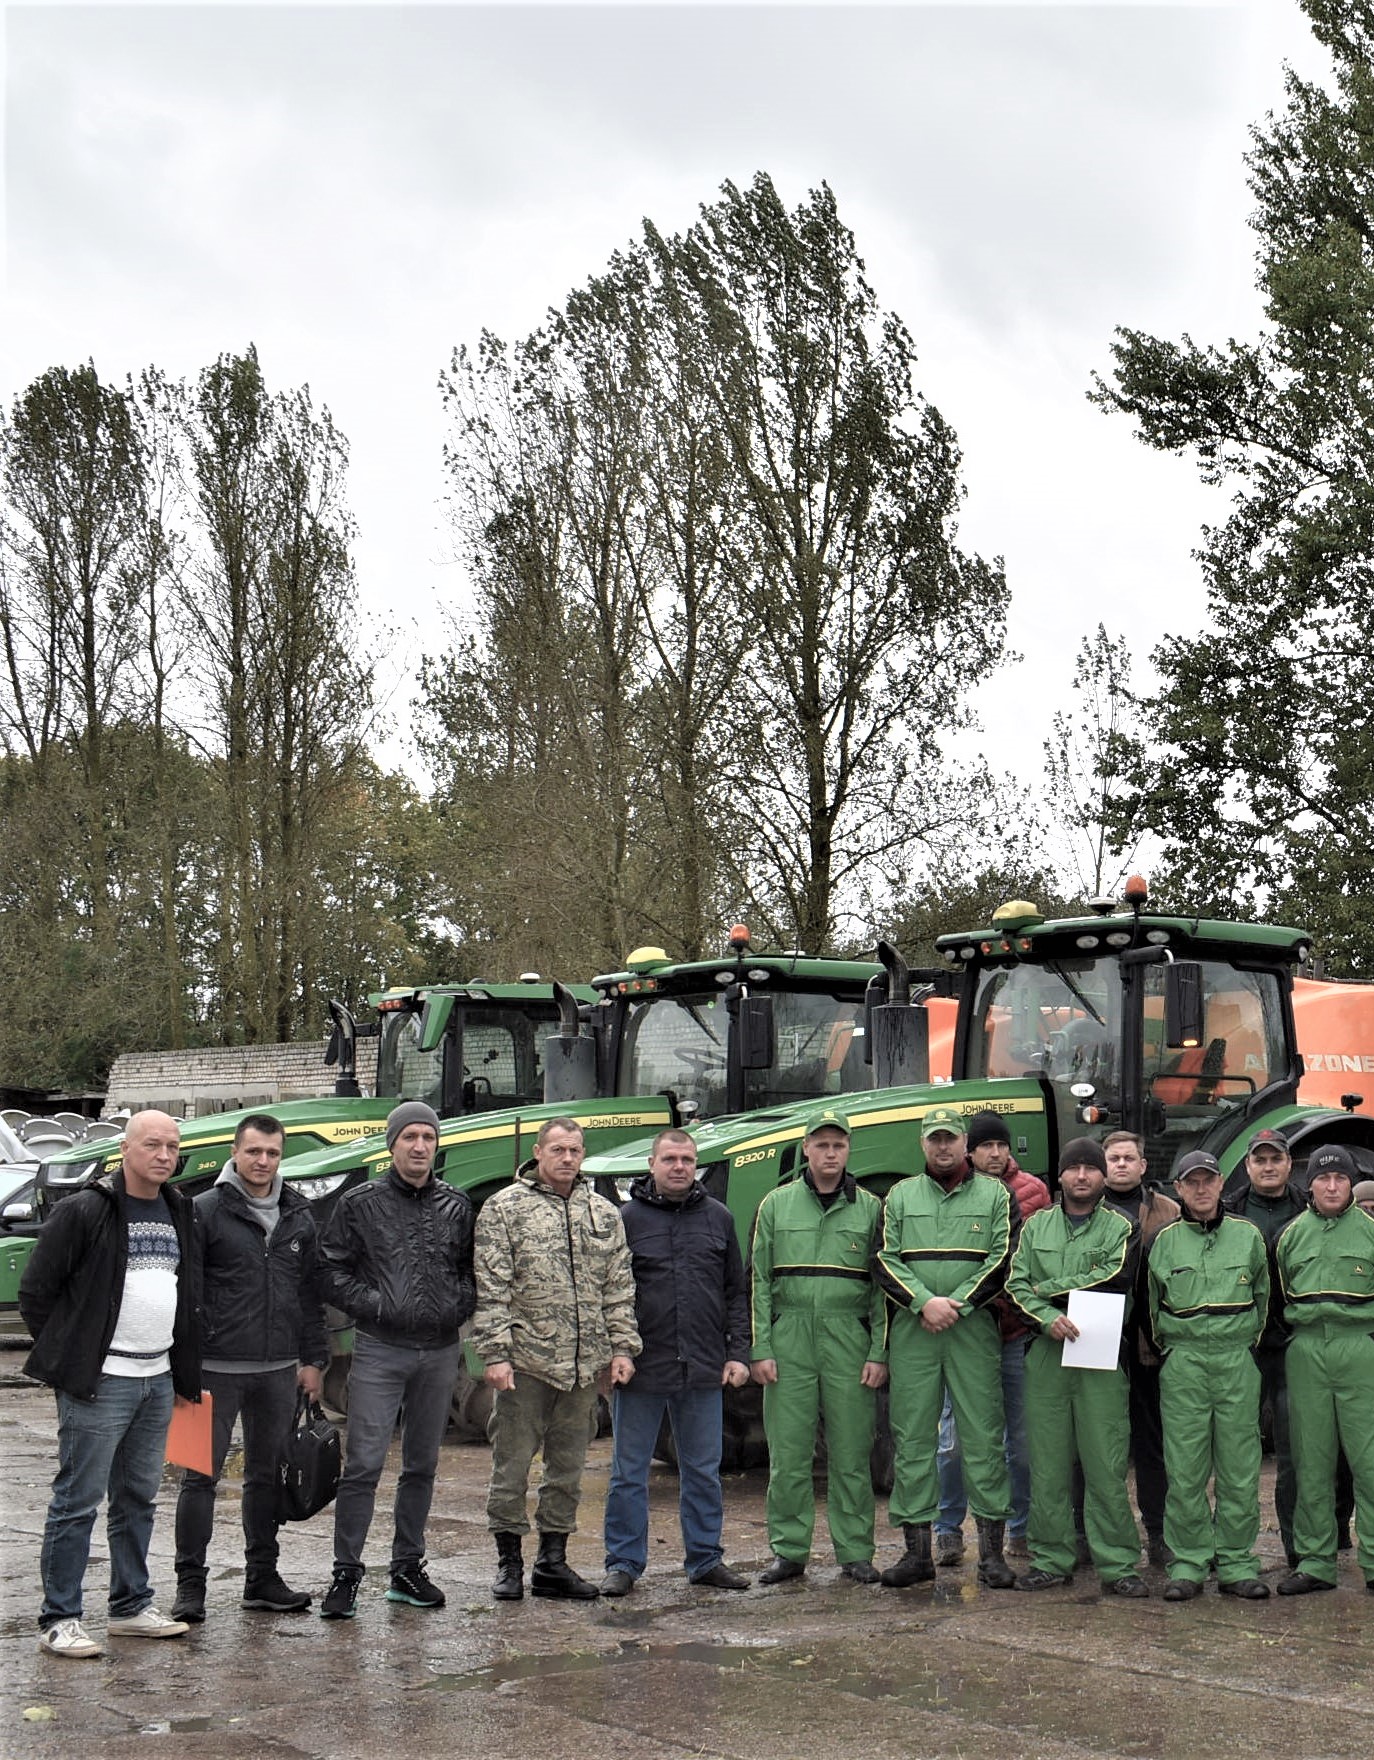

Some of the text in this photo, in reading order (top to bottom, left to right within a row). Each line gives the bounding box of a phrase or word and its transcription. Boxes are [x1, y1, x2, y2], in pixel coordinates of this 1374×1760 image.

[985, 1102, 1016, 1112] DEERE
[587, 1116, 642, 1127] JOHN DEERE
[333, 1127, 361, 1136] JOHN
[734, 1148, 776, 1167] 8320 R
[197, 1160, 217, 1171] 340
